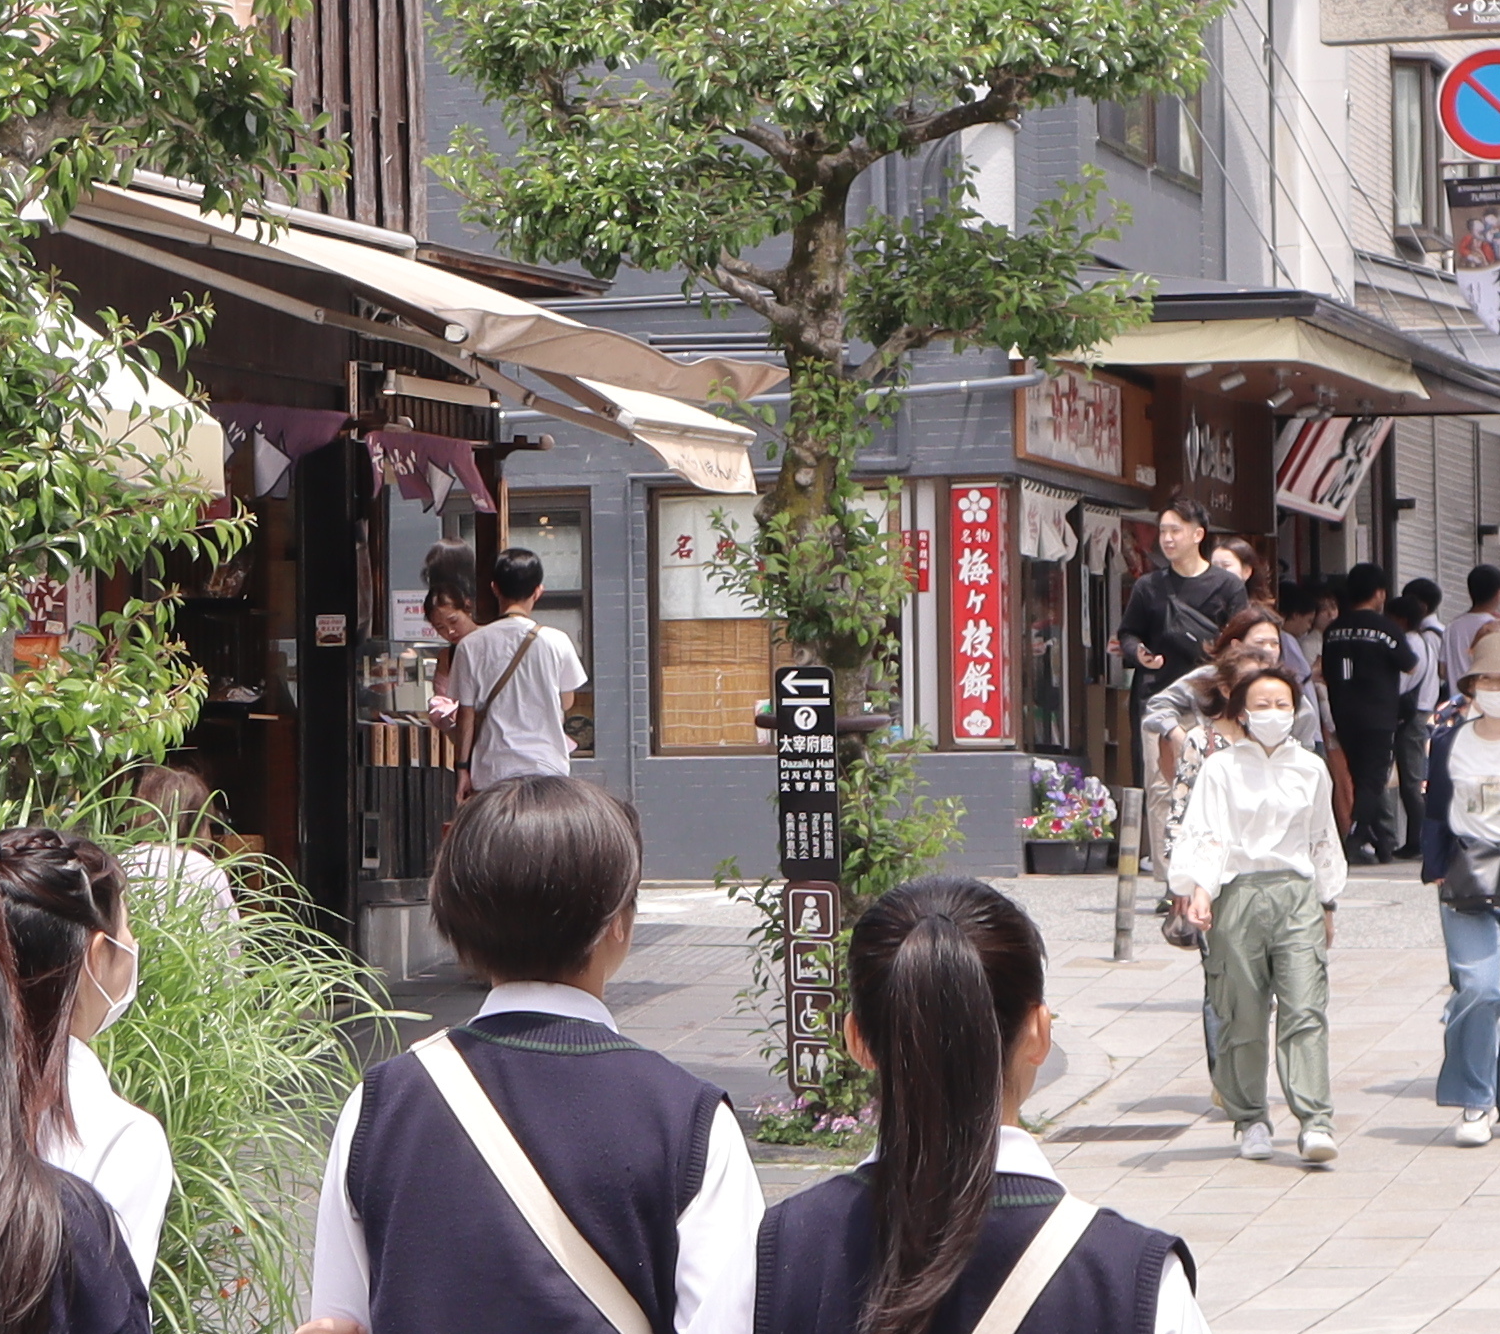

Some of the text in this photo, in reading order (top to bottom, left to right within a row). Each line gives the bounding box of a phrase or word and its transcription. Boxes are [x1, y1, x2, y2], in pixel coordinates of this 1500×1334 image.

[960, 528, 991, 544] 名物
[779, 734, 834, 753] 太宰府館
[780, 758, 834, 769] Dazaifu Hall
